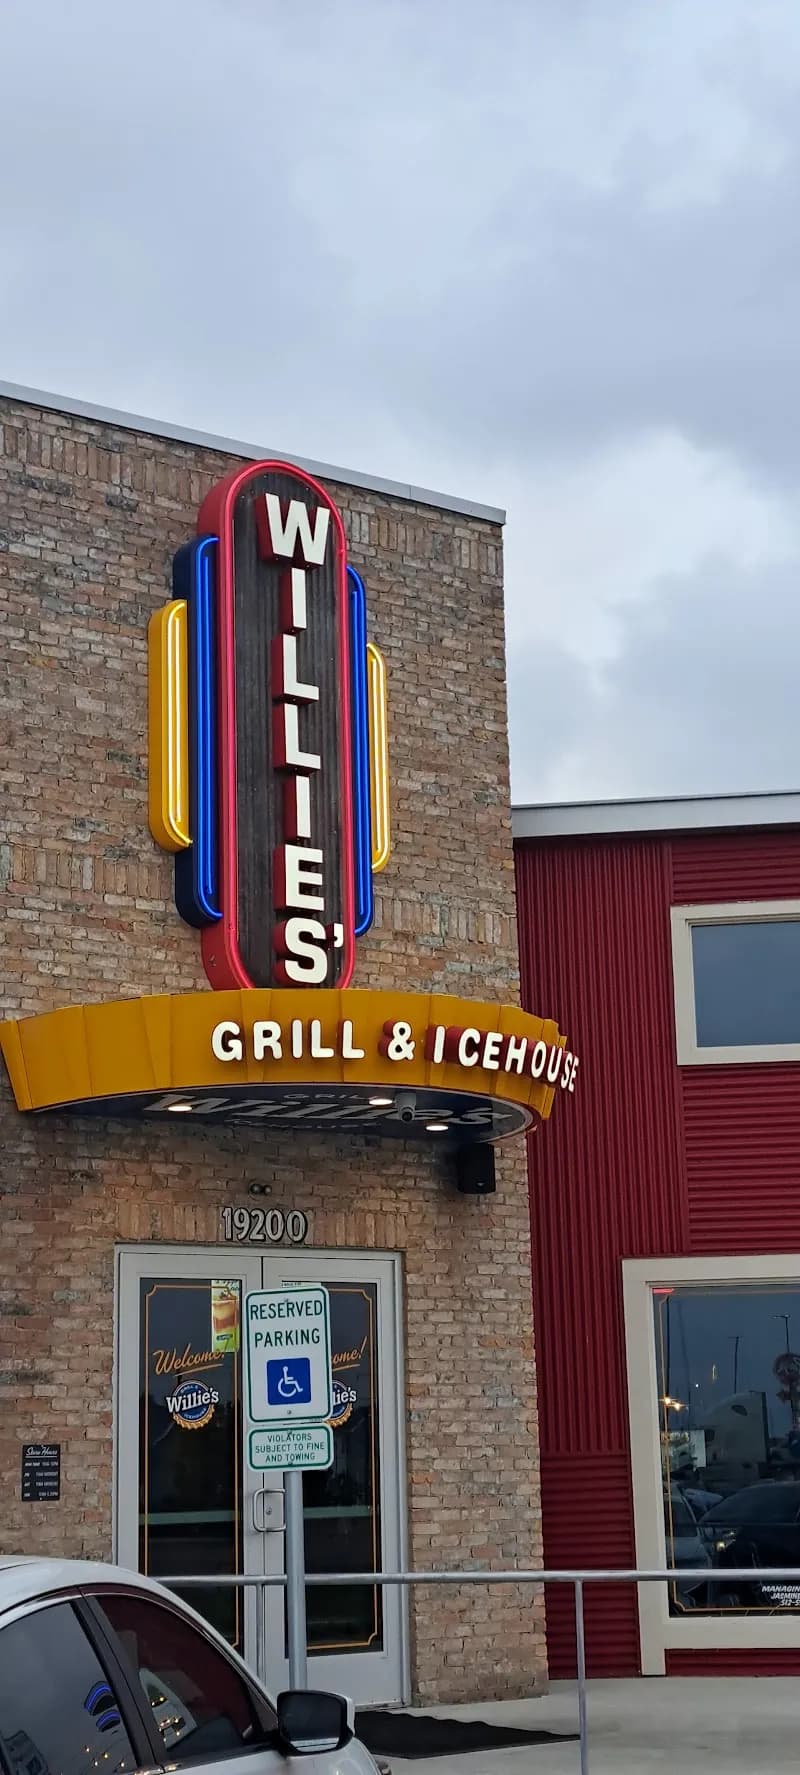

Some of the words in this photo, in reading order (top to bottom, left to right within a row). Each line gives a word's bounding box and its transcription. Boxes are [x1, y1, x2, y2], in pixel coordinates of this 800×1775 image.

[263, 493, 344, 985] WILLIES'
[211, 1019, 366, 1061] GRILL
[386, 1020, 416, 1062] &
[432, 1024, 580, 1094] ICEHOUSE
[222, 1206, 309, 1243] 19200
[250, 1299, 323, 1321] RESERVED
[254, 1327, 321, 1349] PARKING
[331, 1335, 368, 1365] ome!
[152, 1342, 225, 1376] Welcome
[165, 1386, 220, 1414] Willie's
[331, 1386, 357, 1406] lie's
[255, 1443, 291, 1454] SUBJECT
[293, 1443, 304, 1452] TO
[306, 1441, 326, 1451] FINE
[267, 1431, 313, 1443] VIOLATORS
[265, 1453, 283, 1463] AND
[285, 1451, 316, 1462] TOWING
